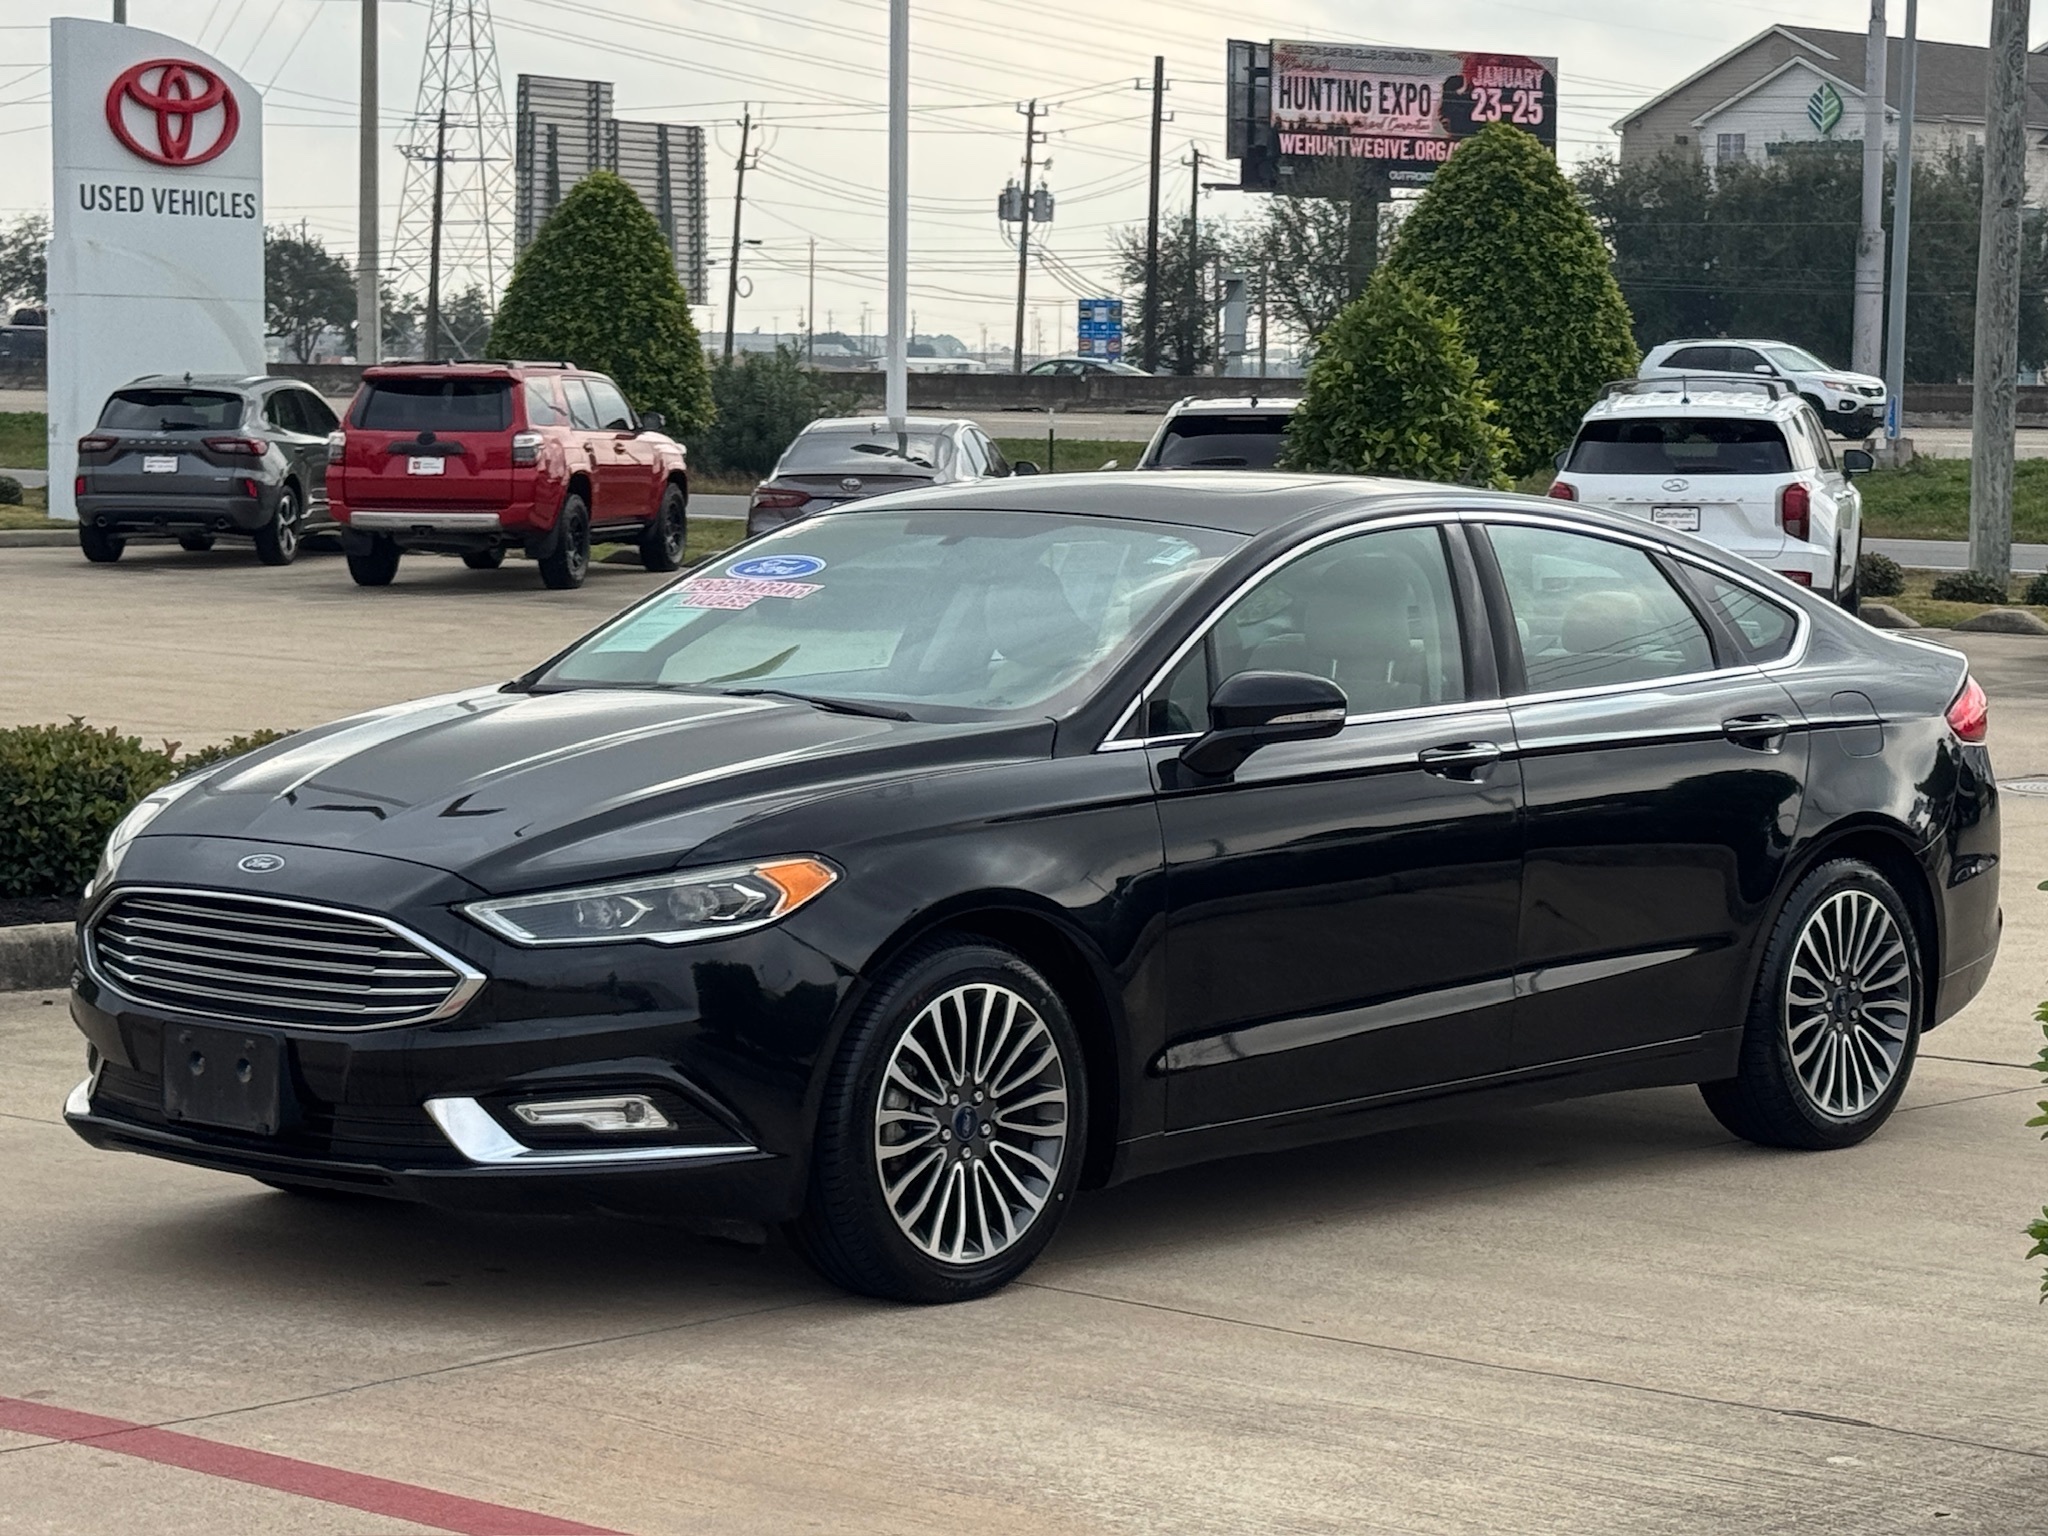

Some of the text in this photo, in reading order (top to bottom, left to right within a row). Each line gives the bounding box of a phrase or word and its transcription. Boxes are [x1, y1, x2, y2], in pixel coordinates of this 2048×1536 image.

[1471, 65, 1545, 90] JANUARY
[1279, 75, 1431, 117] HUNTING EXPO
[1470, 87, 1544, 125] 23-25
[1278, 132, 1461, 162] WEHUNTWEGIVE.ORG/
[79, 183, 256, 219] USED VEHICLES
